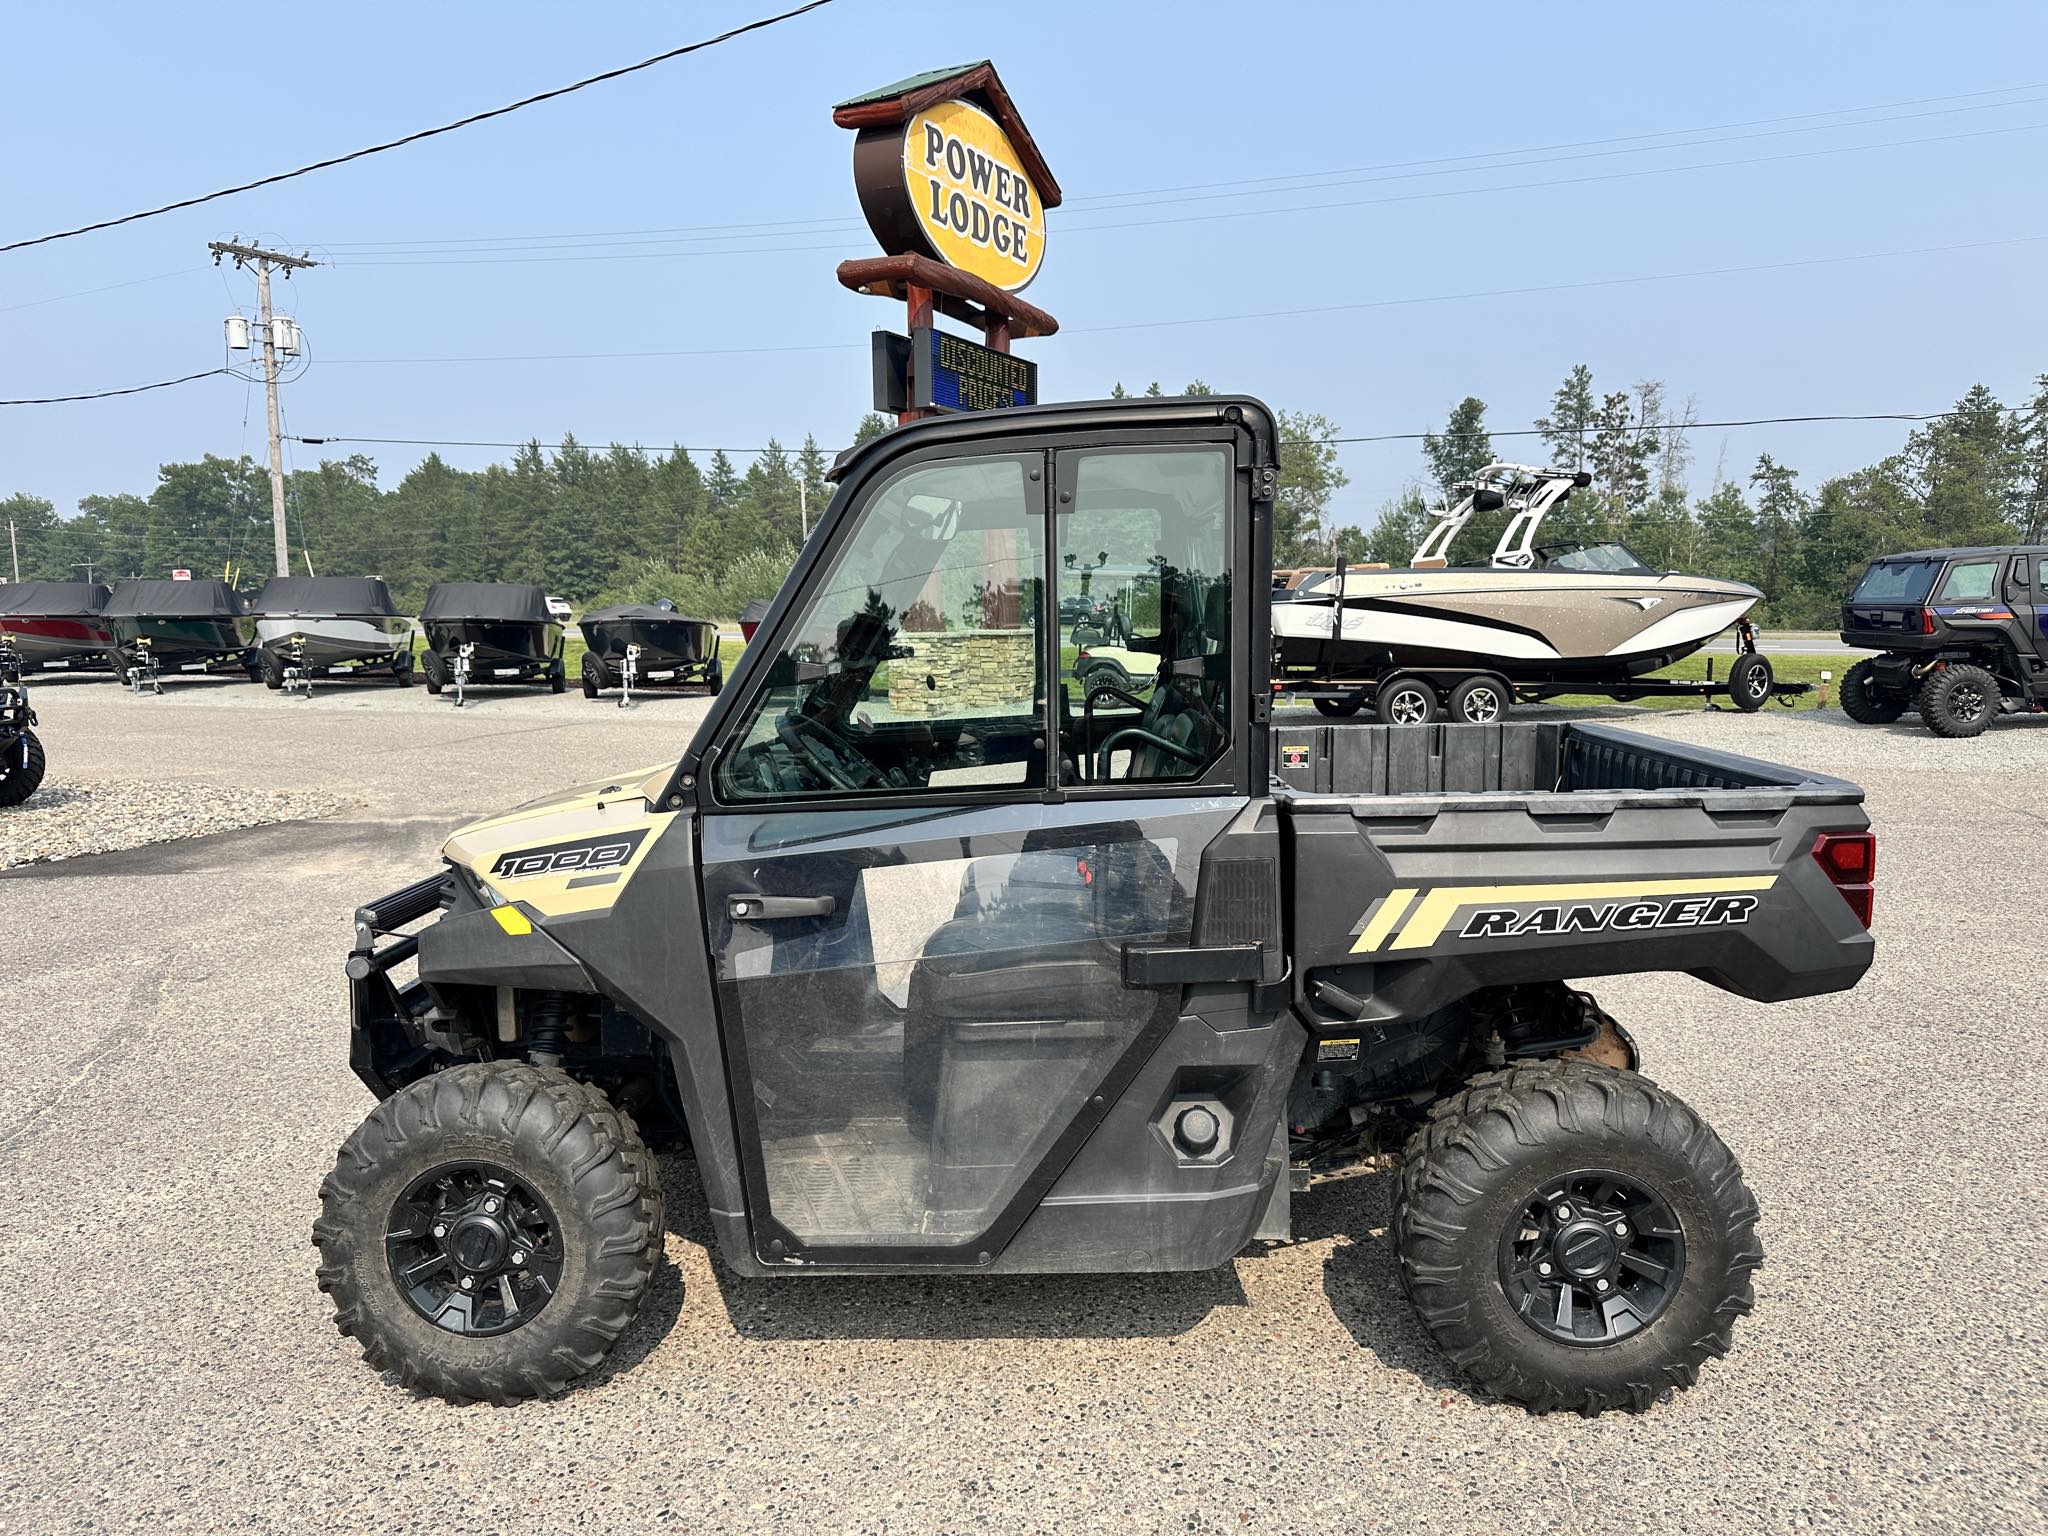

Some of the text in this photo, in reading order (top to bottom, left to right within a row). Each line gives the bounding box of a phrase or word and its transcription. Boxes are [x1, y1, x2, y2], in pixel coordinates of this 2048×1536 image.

[924, 122, 1031, 220] POWER
[930, 179, 1028, 264] LODGE
[940, 336, 1028, 392] DISCOUNTED
[499, 842, 631, 880] 1000
[1458, 895, 1760, 938] RANGER
